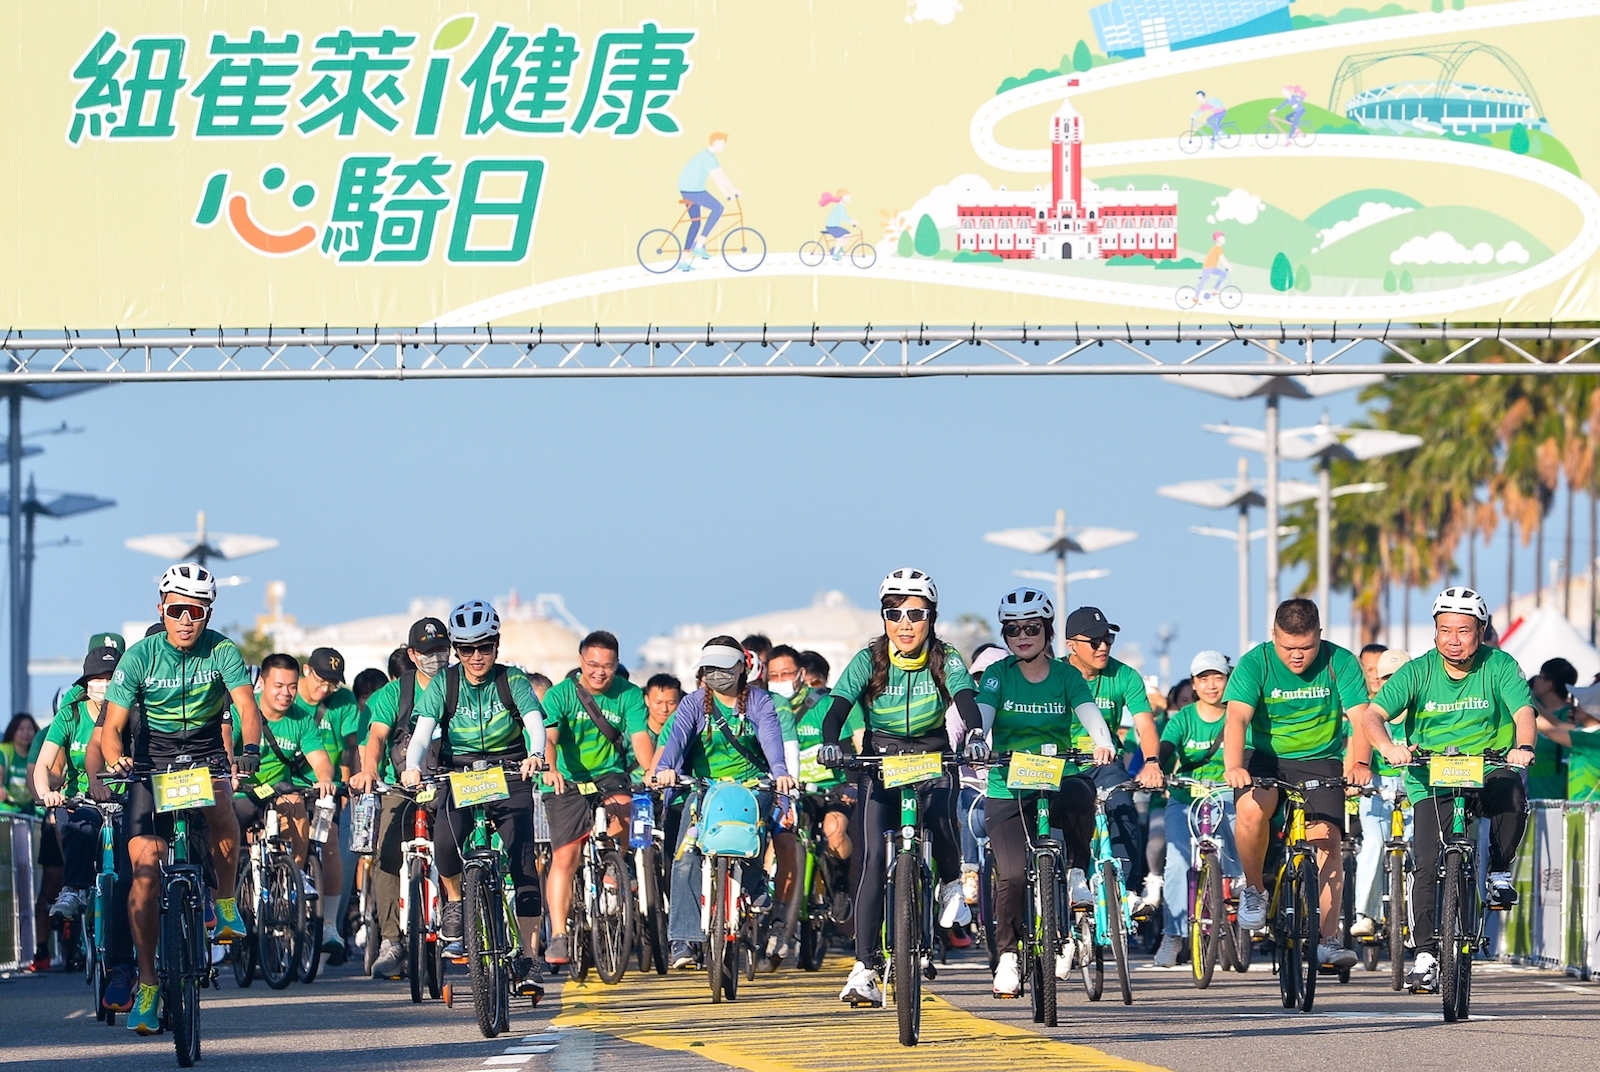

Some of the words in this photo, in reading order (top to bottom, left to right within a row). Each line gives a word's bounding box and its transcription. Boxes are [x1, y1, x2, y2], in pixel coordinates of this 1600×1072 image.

[69, 16, 698, 143] 紐崔萊i健康
[194, 155, 546, 263] 心騎日
[1282, 687, 1331, 699] nutrilite
[1437, 697, 1490, 712] nutrilite
[886, 760, 939, 777] Michelle
[1016, 767, 1054, 779] Gloria
[1442, 766, 1471, 777] Alex
[460, 781, 499, 795] Nadia
[901, 798, 917, 812] 90
